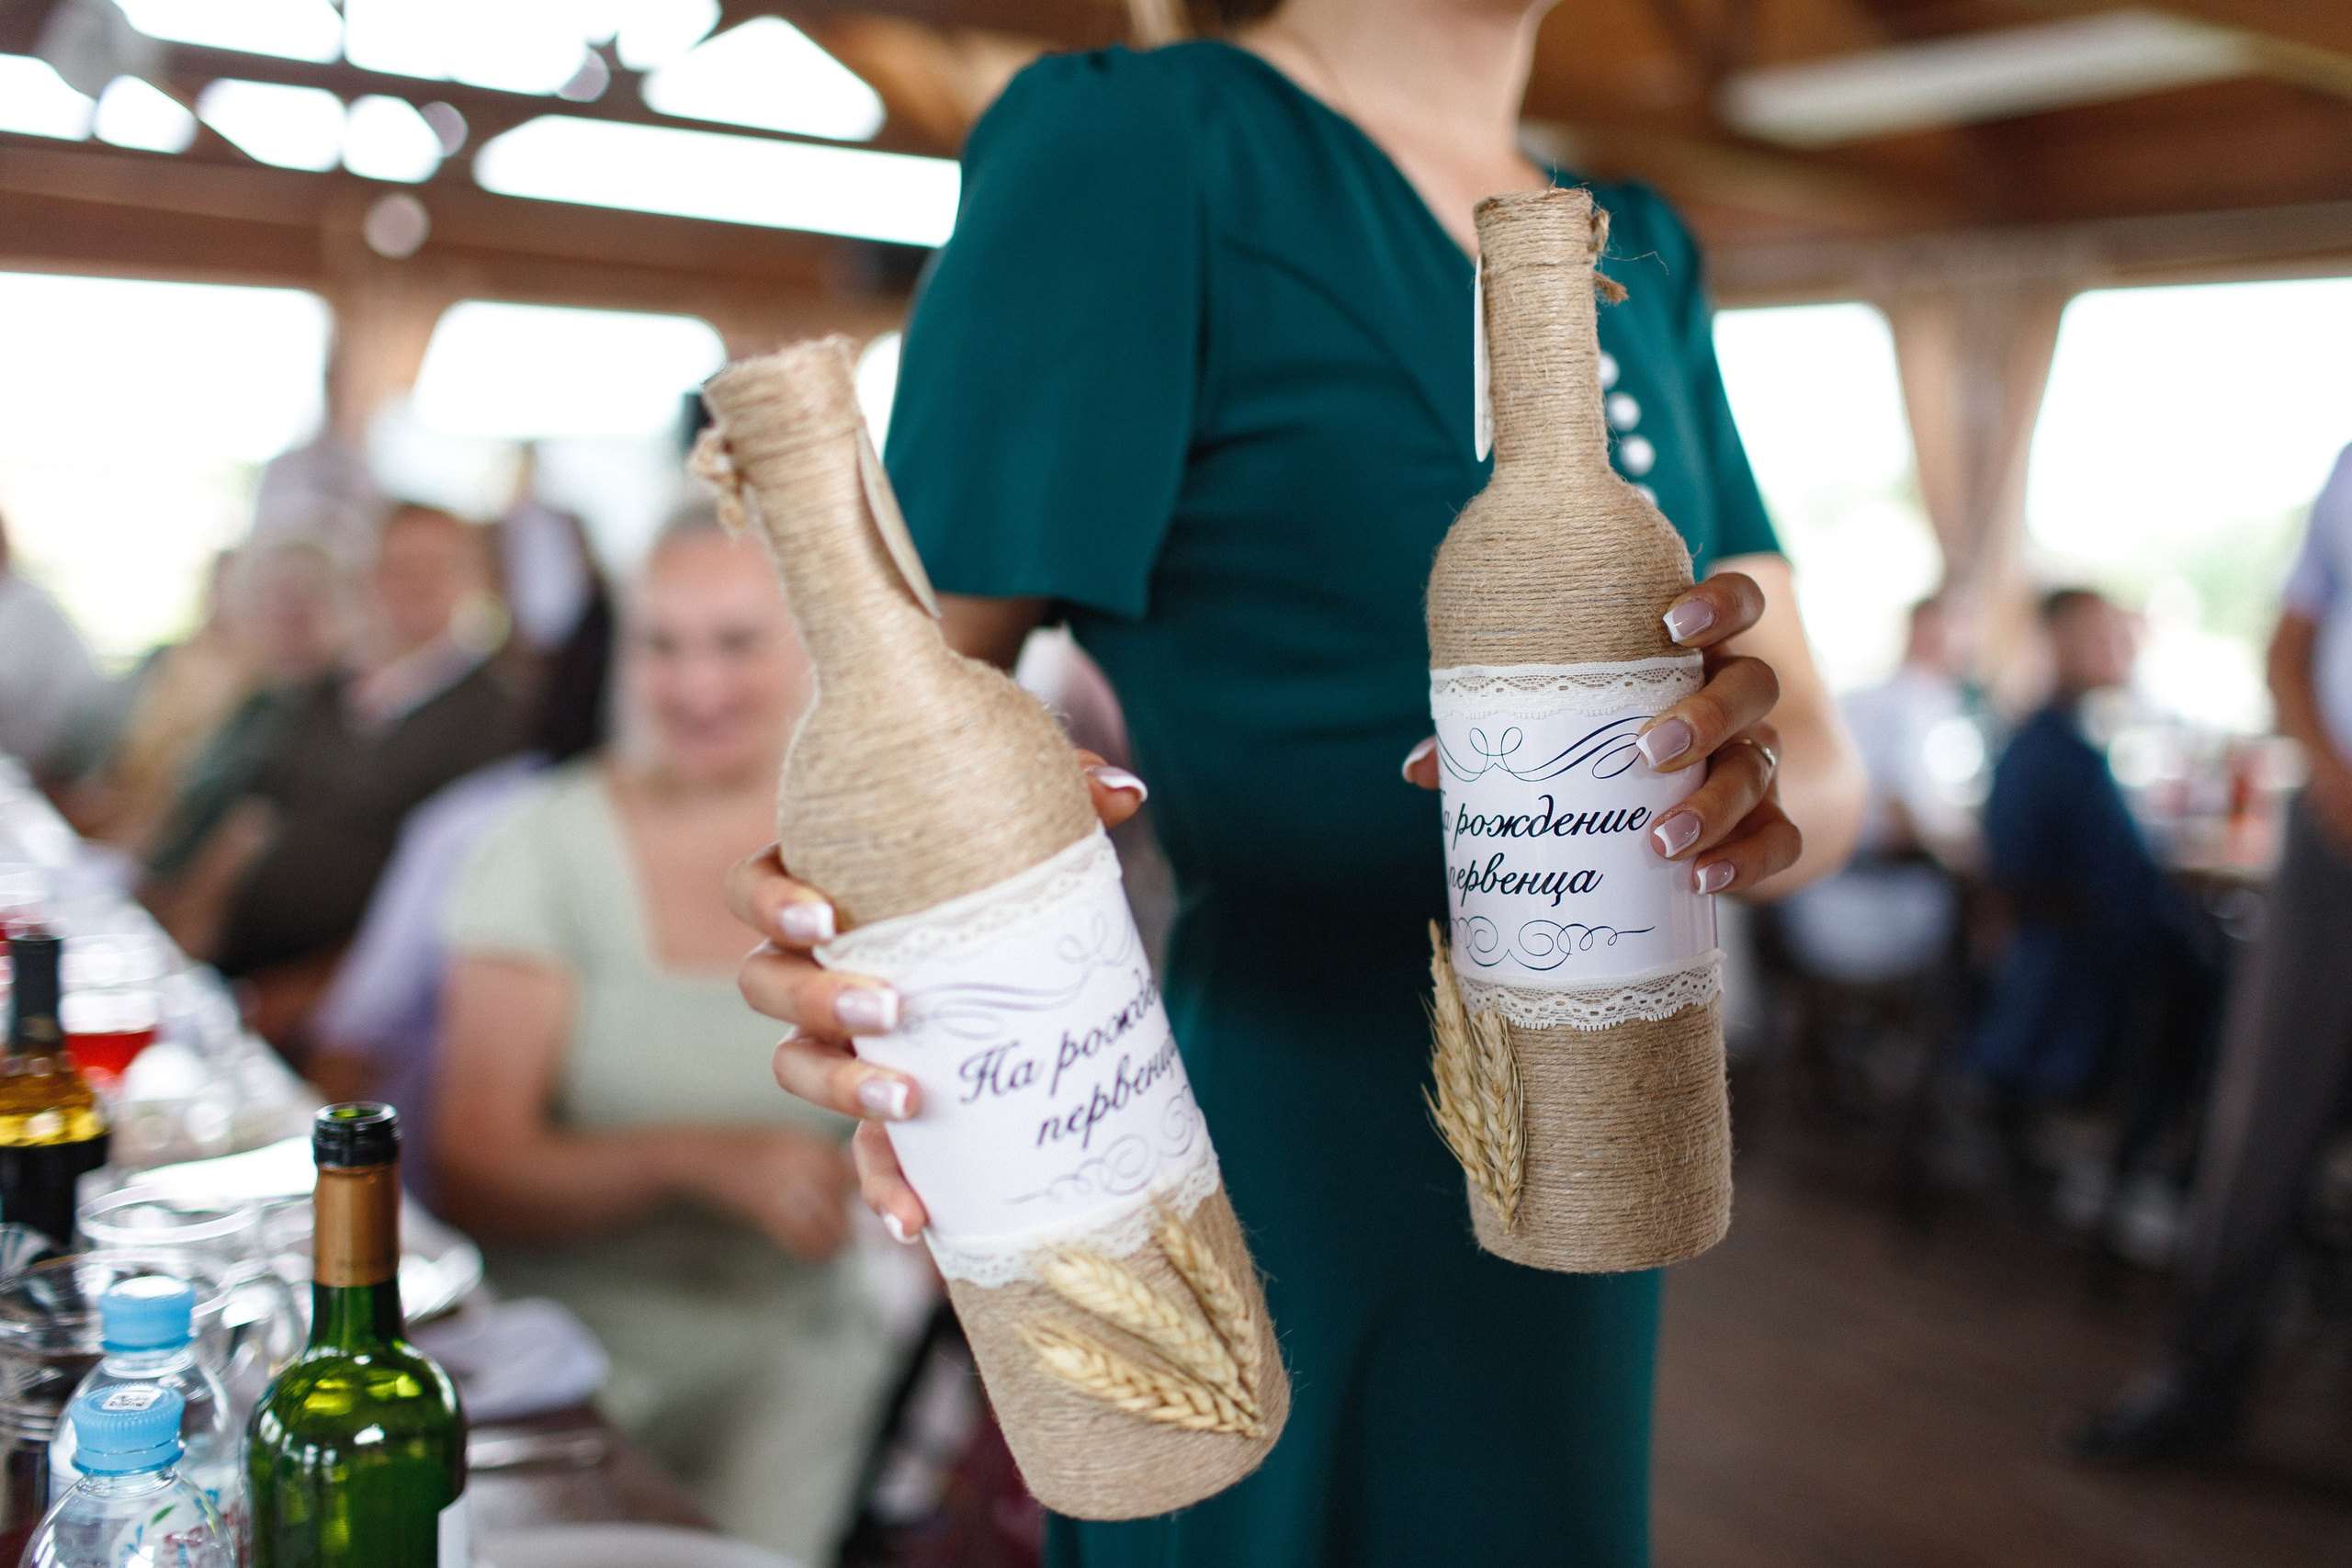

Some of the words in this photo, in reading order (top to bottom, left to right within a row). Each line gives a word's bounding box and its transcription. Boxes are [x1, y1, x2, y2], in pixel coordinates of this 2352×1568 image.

[1452, 794, 1653, 852] рождение
[1448, 852, 1604, 908] первенца
[958, 1040, 1038, 1102] На
